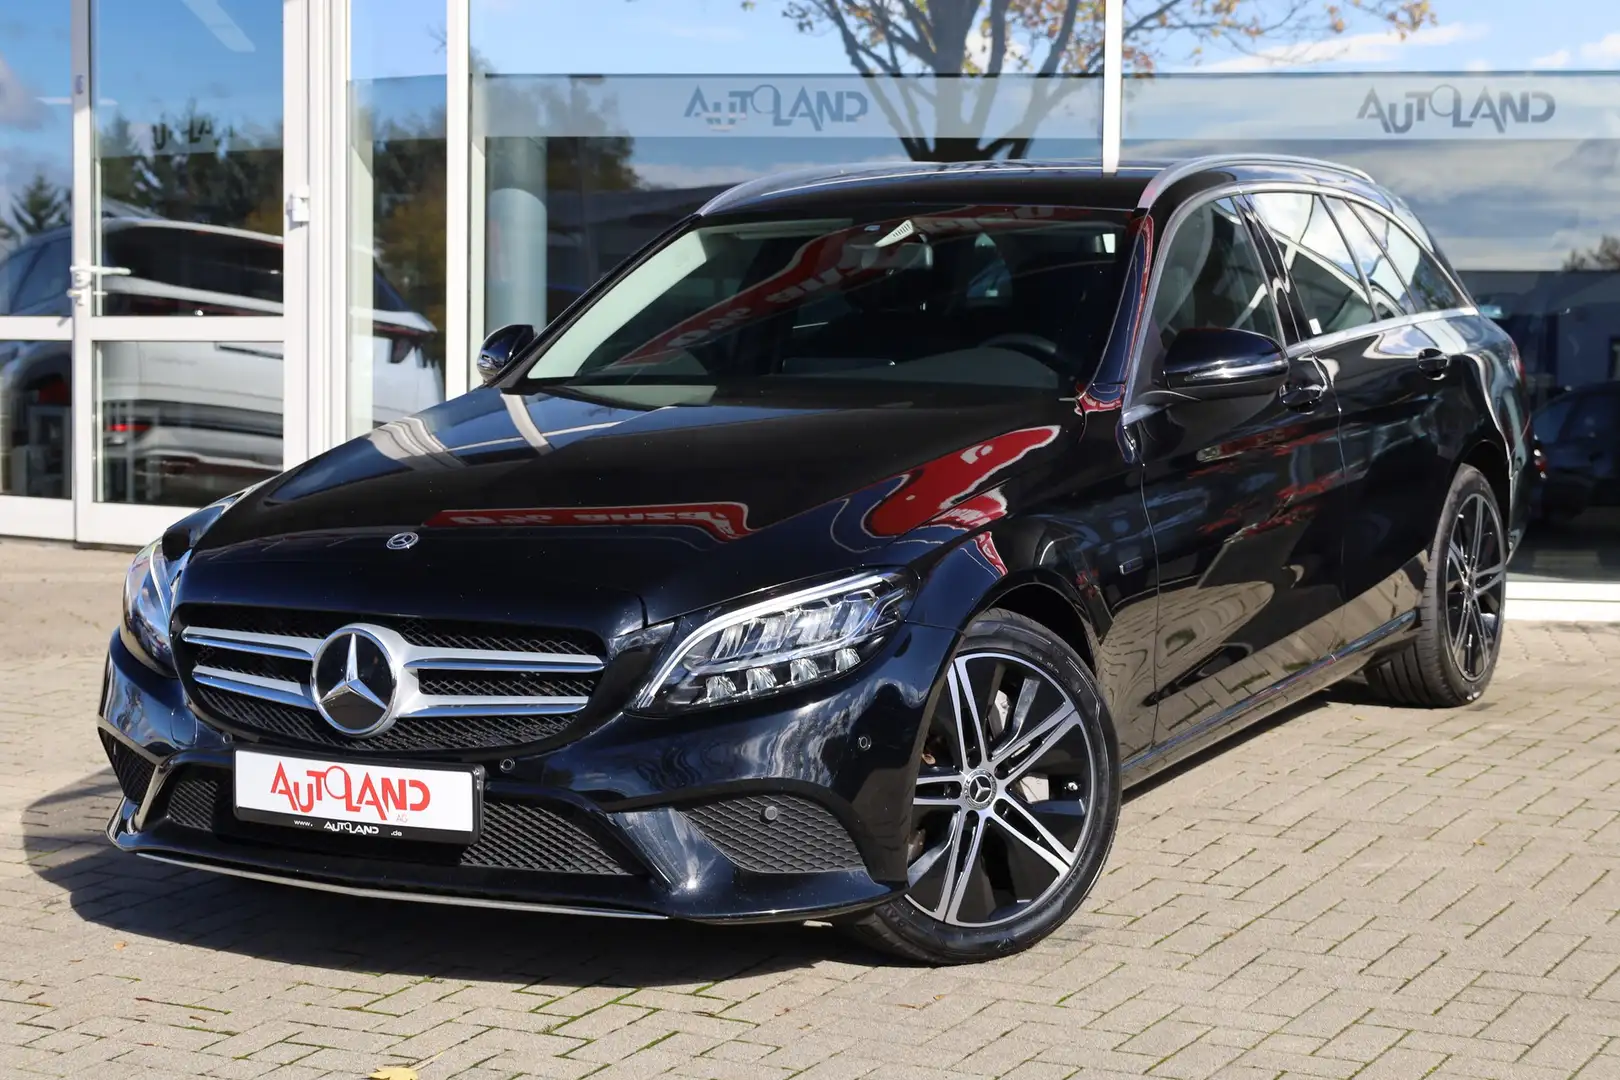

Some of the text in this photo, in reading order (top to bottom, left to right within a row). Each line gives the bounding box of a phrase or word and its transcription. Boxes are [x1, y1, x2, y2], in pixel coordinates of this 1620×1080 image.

[684, 84, 868, 131] AUTOLAND
[1356, 84, 1556, 134] AUTOLAND
[270, 761, 431, 820] AUTOLAND
[323, 821, 379, 835] AUTOLAND
